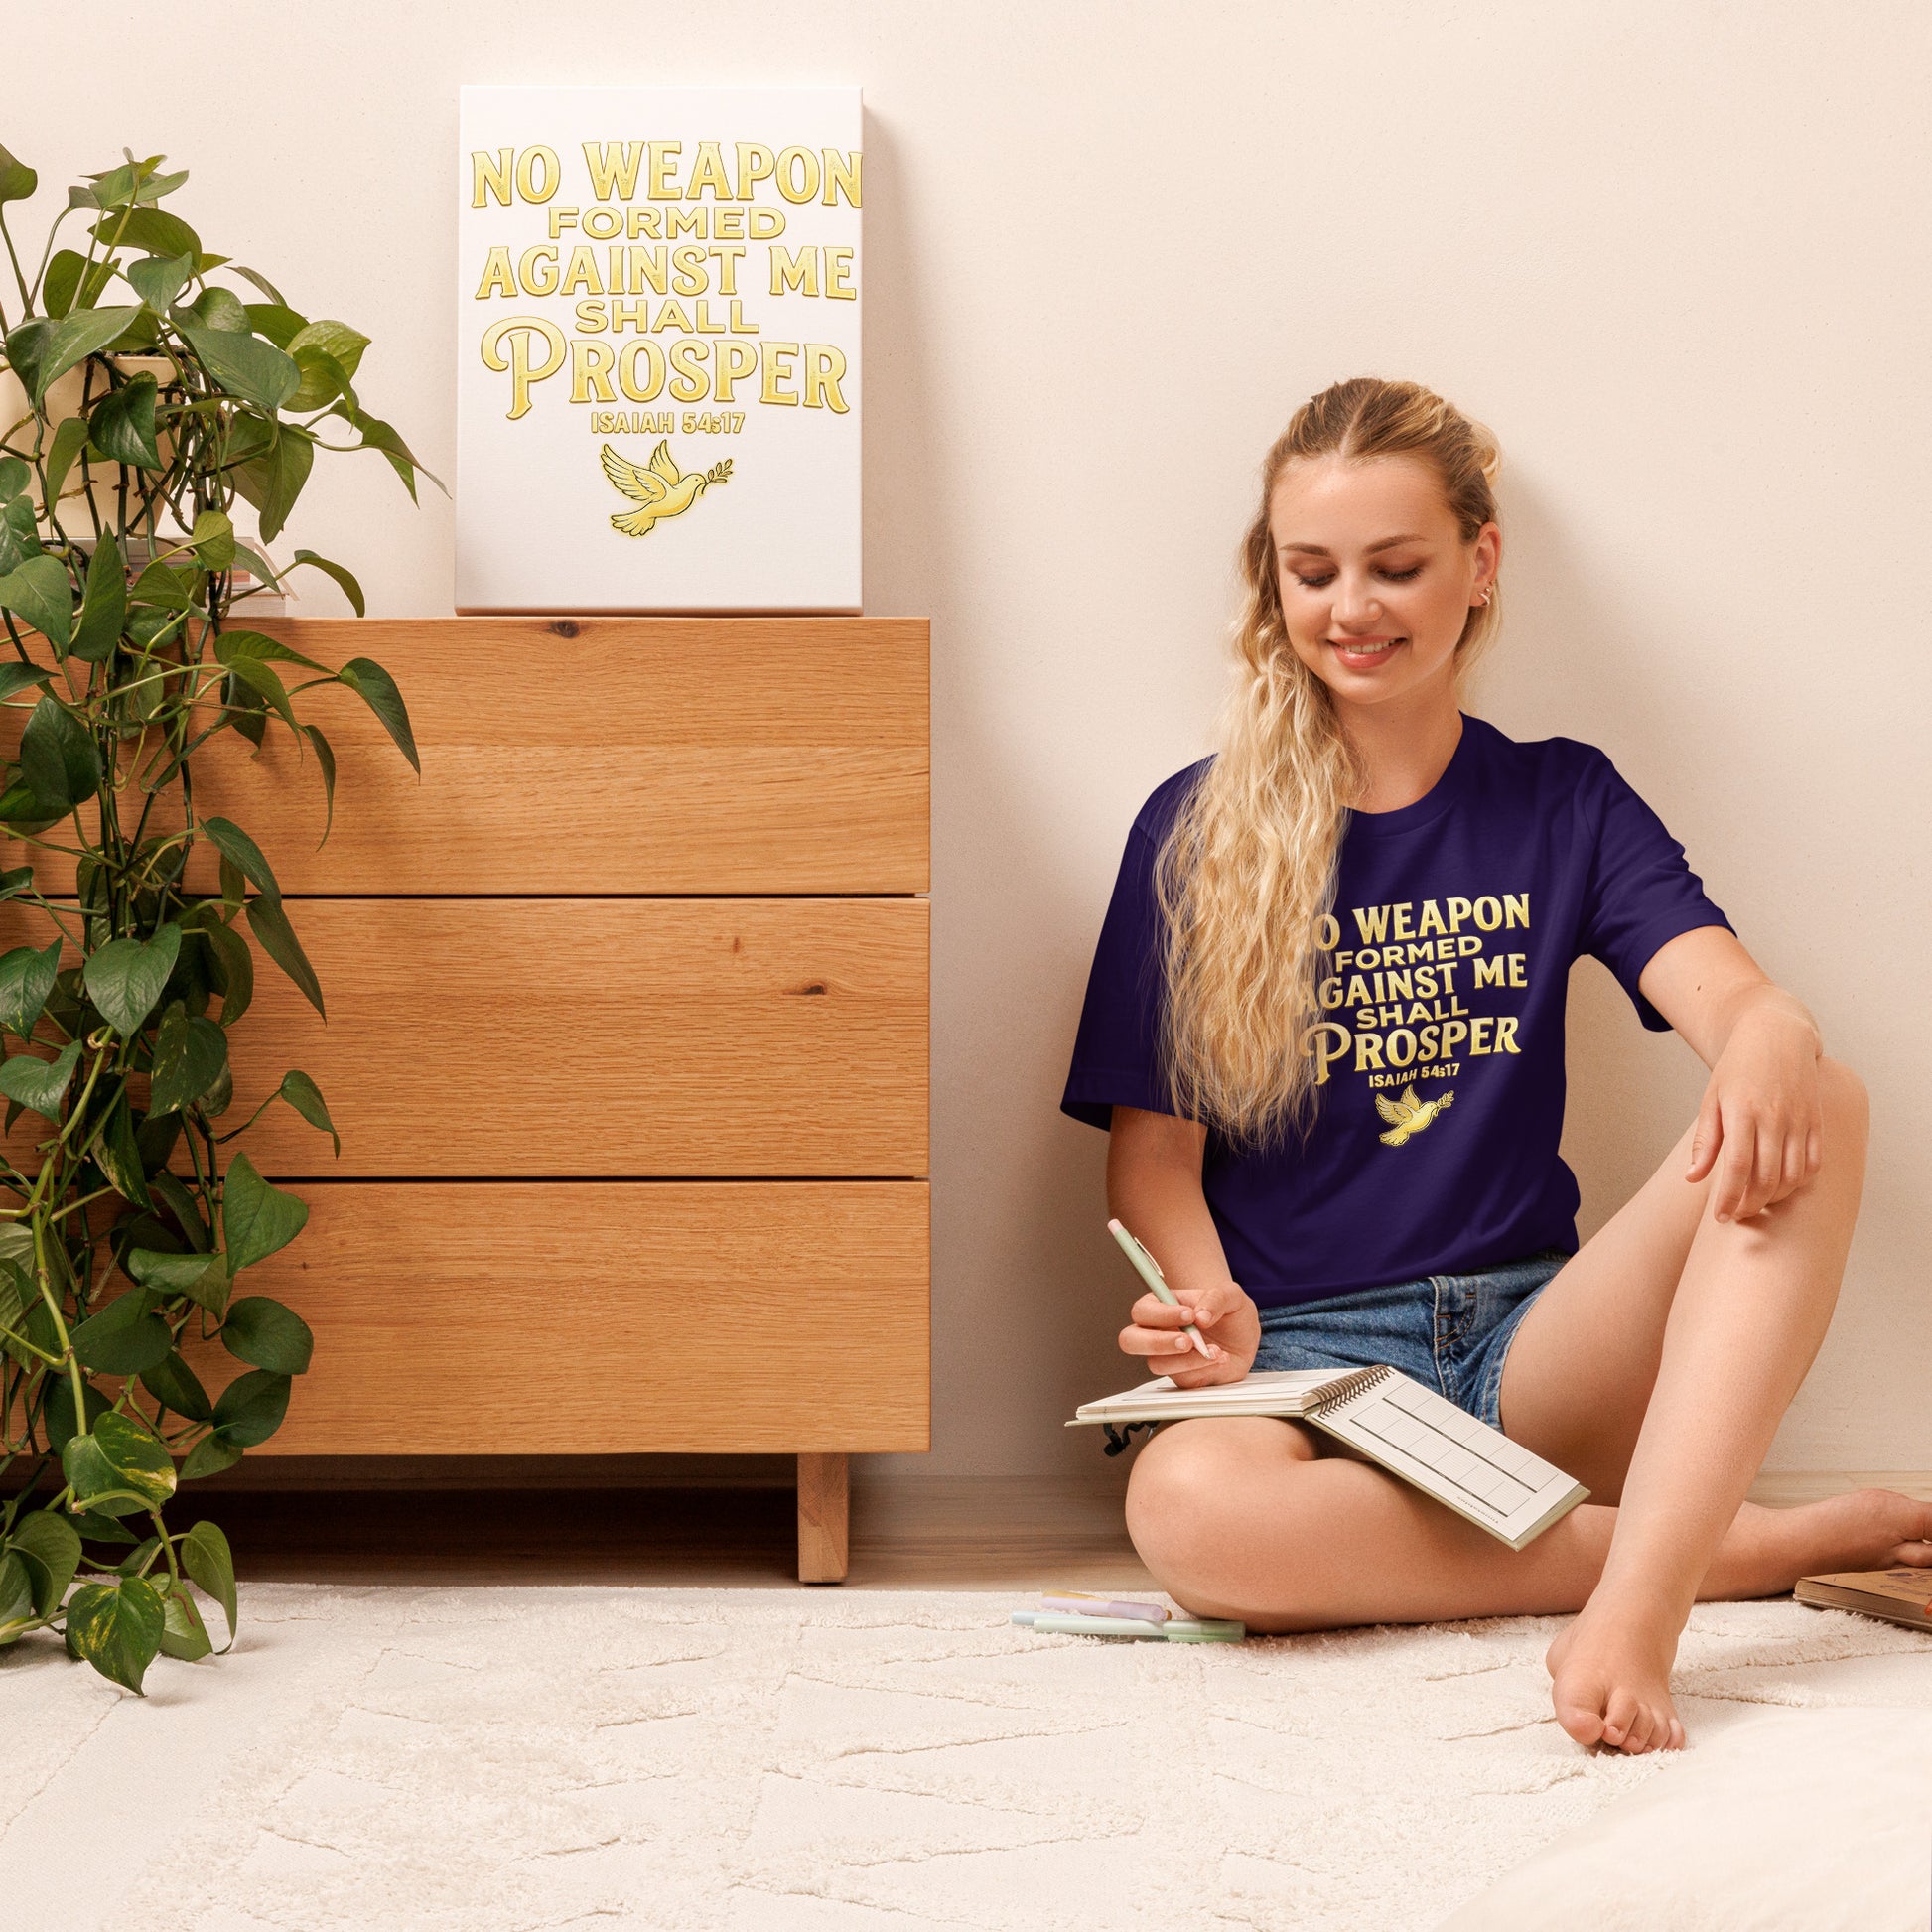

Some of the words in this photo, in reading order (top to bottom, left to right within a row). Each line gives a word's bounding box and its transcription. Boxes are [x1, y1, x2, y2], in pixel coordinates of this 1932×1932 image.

[471, 144, 561, 208] NO
[581, 140, 863, 209] WEAPON
[548, 207, 786, 240] FORMED
[475, 245, 746, 301] AGAINST
[768, 246, 857, 301] ME
[575, 300, 760, 334] SHALL
[481, 316, 850, 420] PROSPER
[591, 411, 675, 434] ISAIAH
[1352, 893, 1530, 945] WEAPON
[1335, 935, 1483, 972] FORMED
[1472, 953, 1528, 989] ME
[1356, 995, 1469, 1030] SHALL
[1299, 1017, 1522, 1086] PROSPER
[1368, 1068, 1418, 1088] ISAIAH
